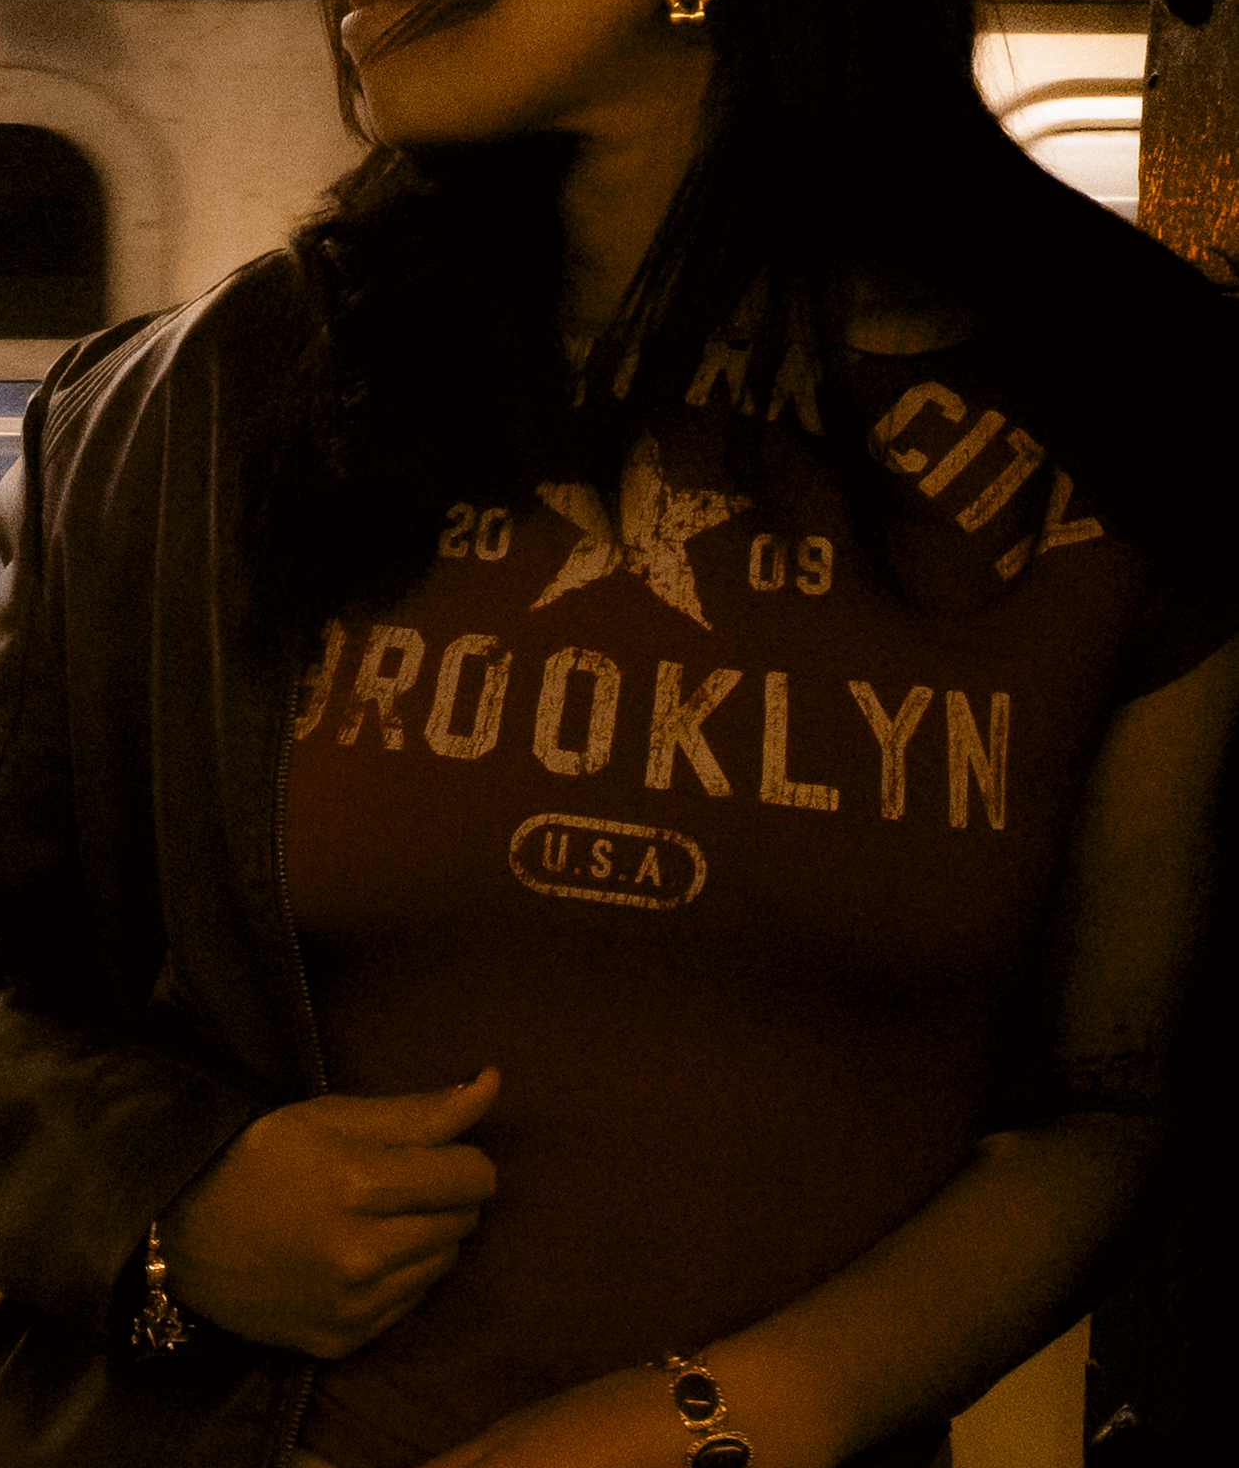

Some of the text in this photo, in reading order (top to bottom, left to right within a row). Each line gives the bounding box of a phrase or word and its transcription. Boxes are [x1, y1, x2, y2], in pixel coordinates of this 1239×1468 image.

[437, 501, 834, 596] 20 09
[866, 381, 1105, 582] CITY
